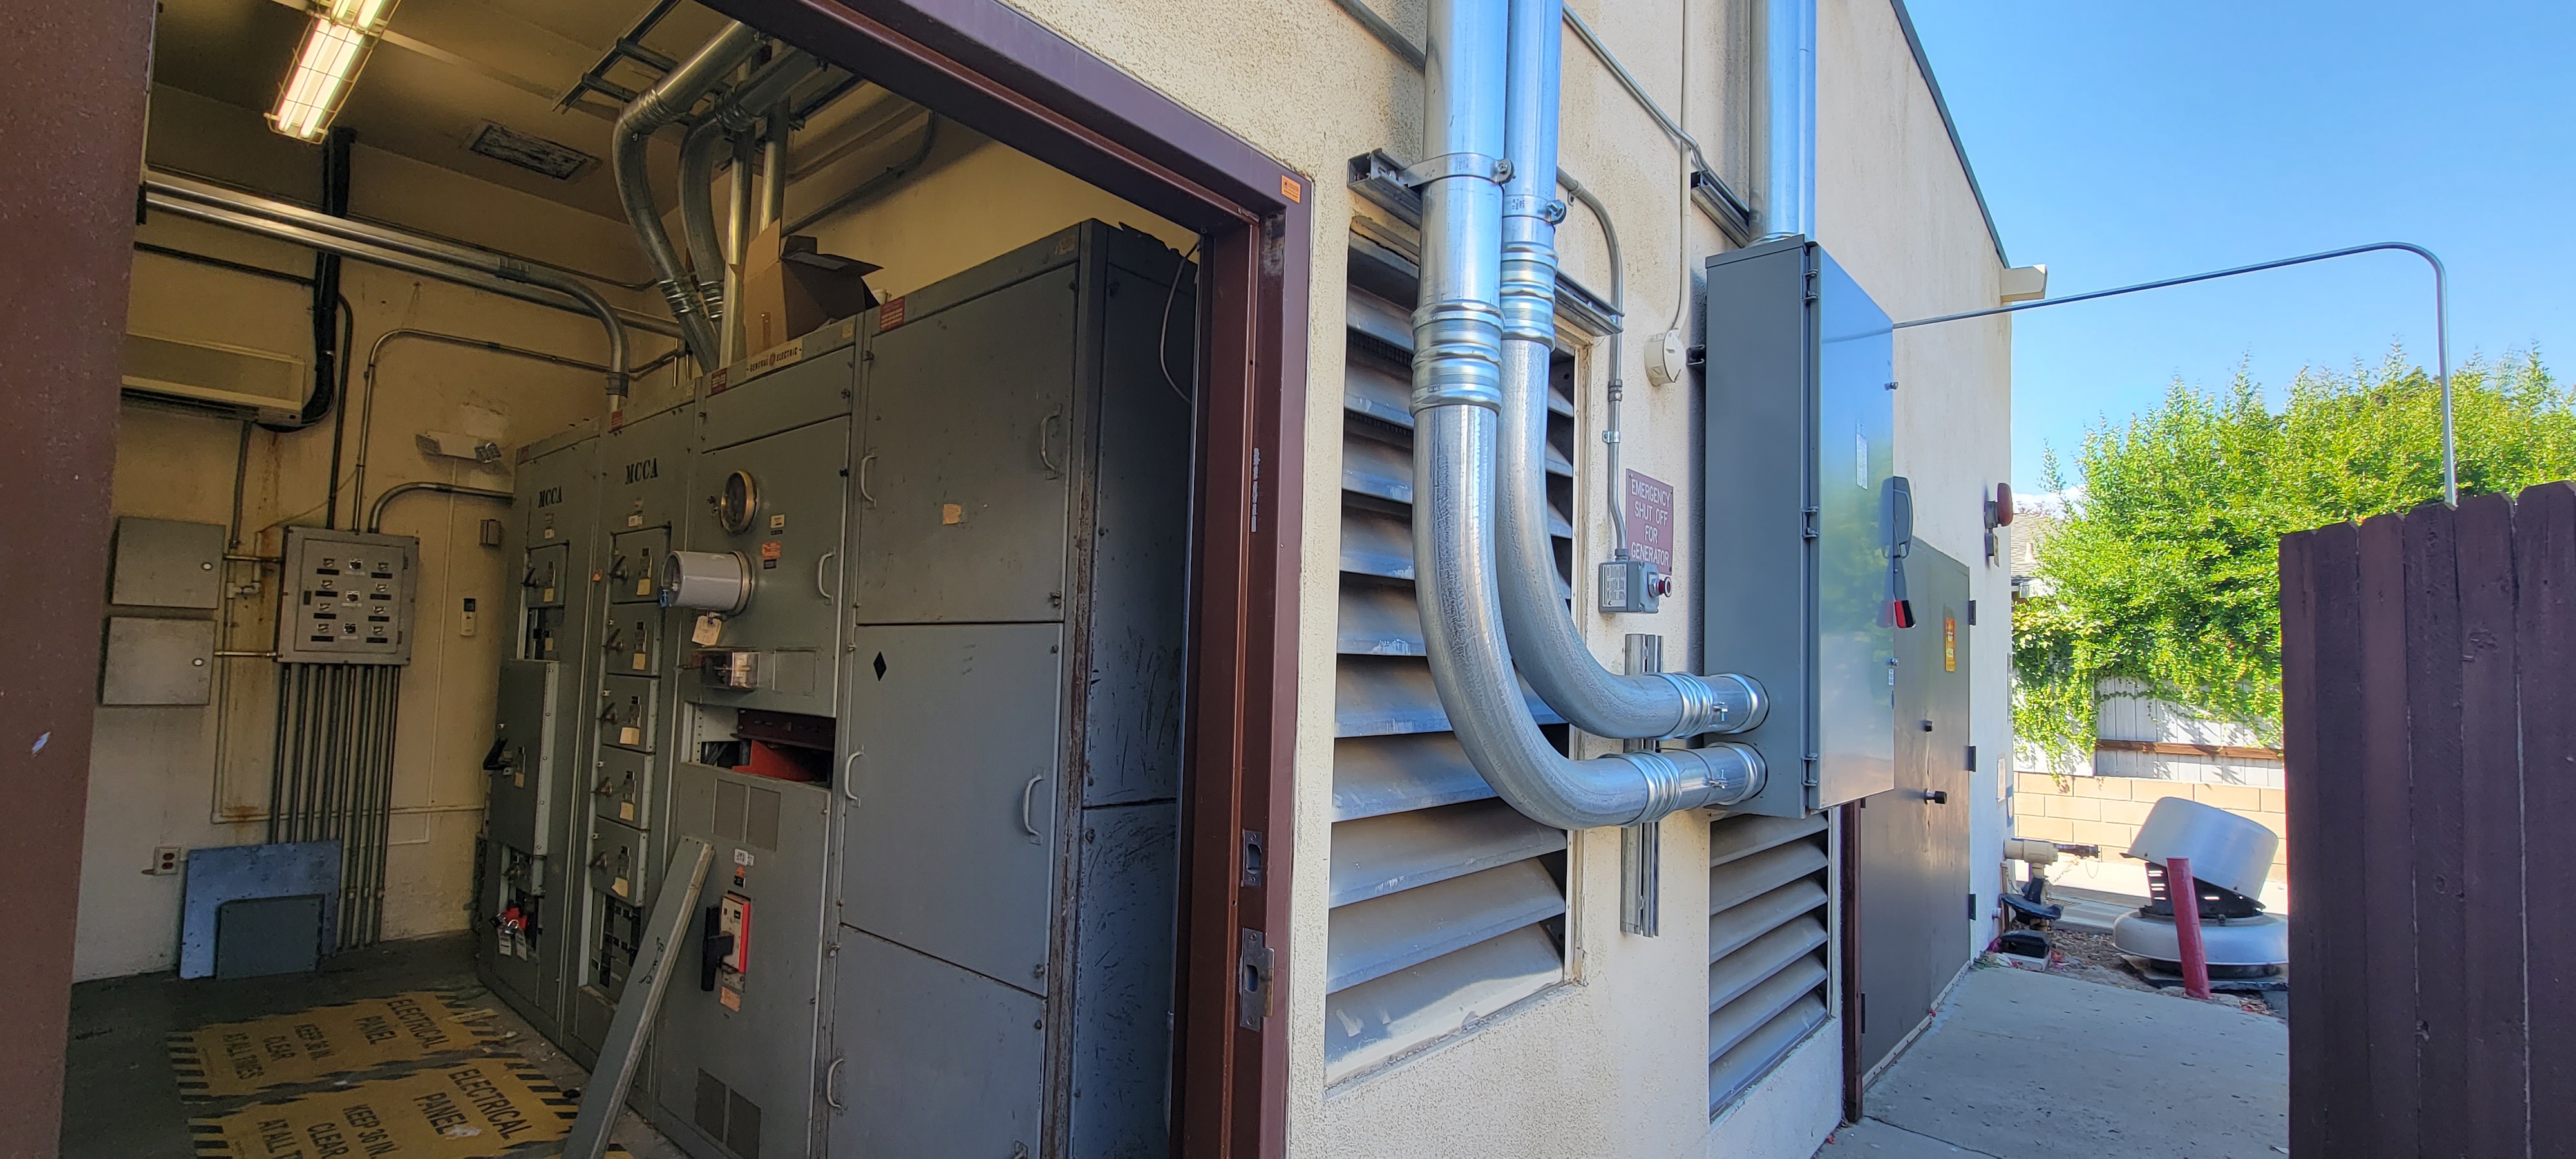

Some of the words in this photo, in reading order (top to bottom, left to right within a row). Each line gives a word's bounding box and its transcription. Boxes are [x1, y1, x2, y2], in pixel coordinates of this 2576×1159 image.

[776, 346, 797, 362] ELECTRIC
[625, 458, 658, 485] MCCA
[538, 486, 562, 508] MCCA
[1631, 478, 1671, 507] EMERGENCY
[1634, 501, 1653, 522] SHUT
[1656, 508, 1668, 527] OFF
[1645, 523, 1658, 544] FOR
[1631, 542, 1669, 567] GENERATOR
[355, 1015, 397, 1045] PANEL
[387, 999, 450, 1049] ELECTRICAL
[227, 1042, 253, 1057] ALL
[263, 1035, 296, 1061] CLEAR
[343, 1104, 381, 1128] KEEP
[413, 1092, 468, 1135] PANEL
[448, 1069, 532, 1140] ELECTRICAL
[257, 1118, 290, 1133] AT
[357, 1128, 389, 1143] 36
[261, 1132, 297, 1154] ALL
[307, 1122, 350, 1159] CLEAR
